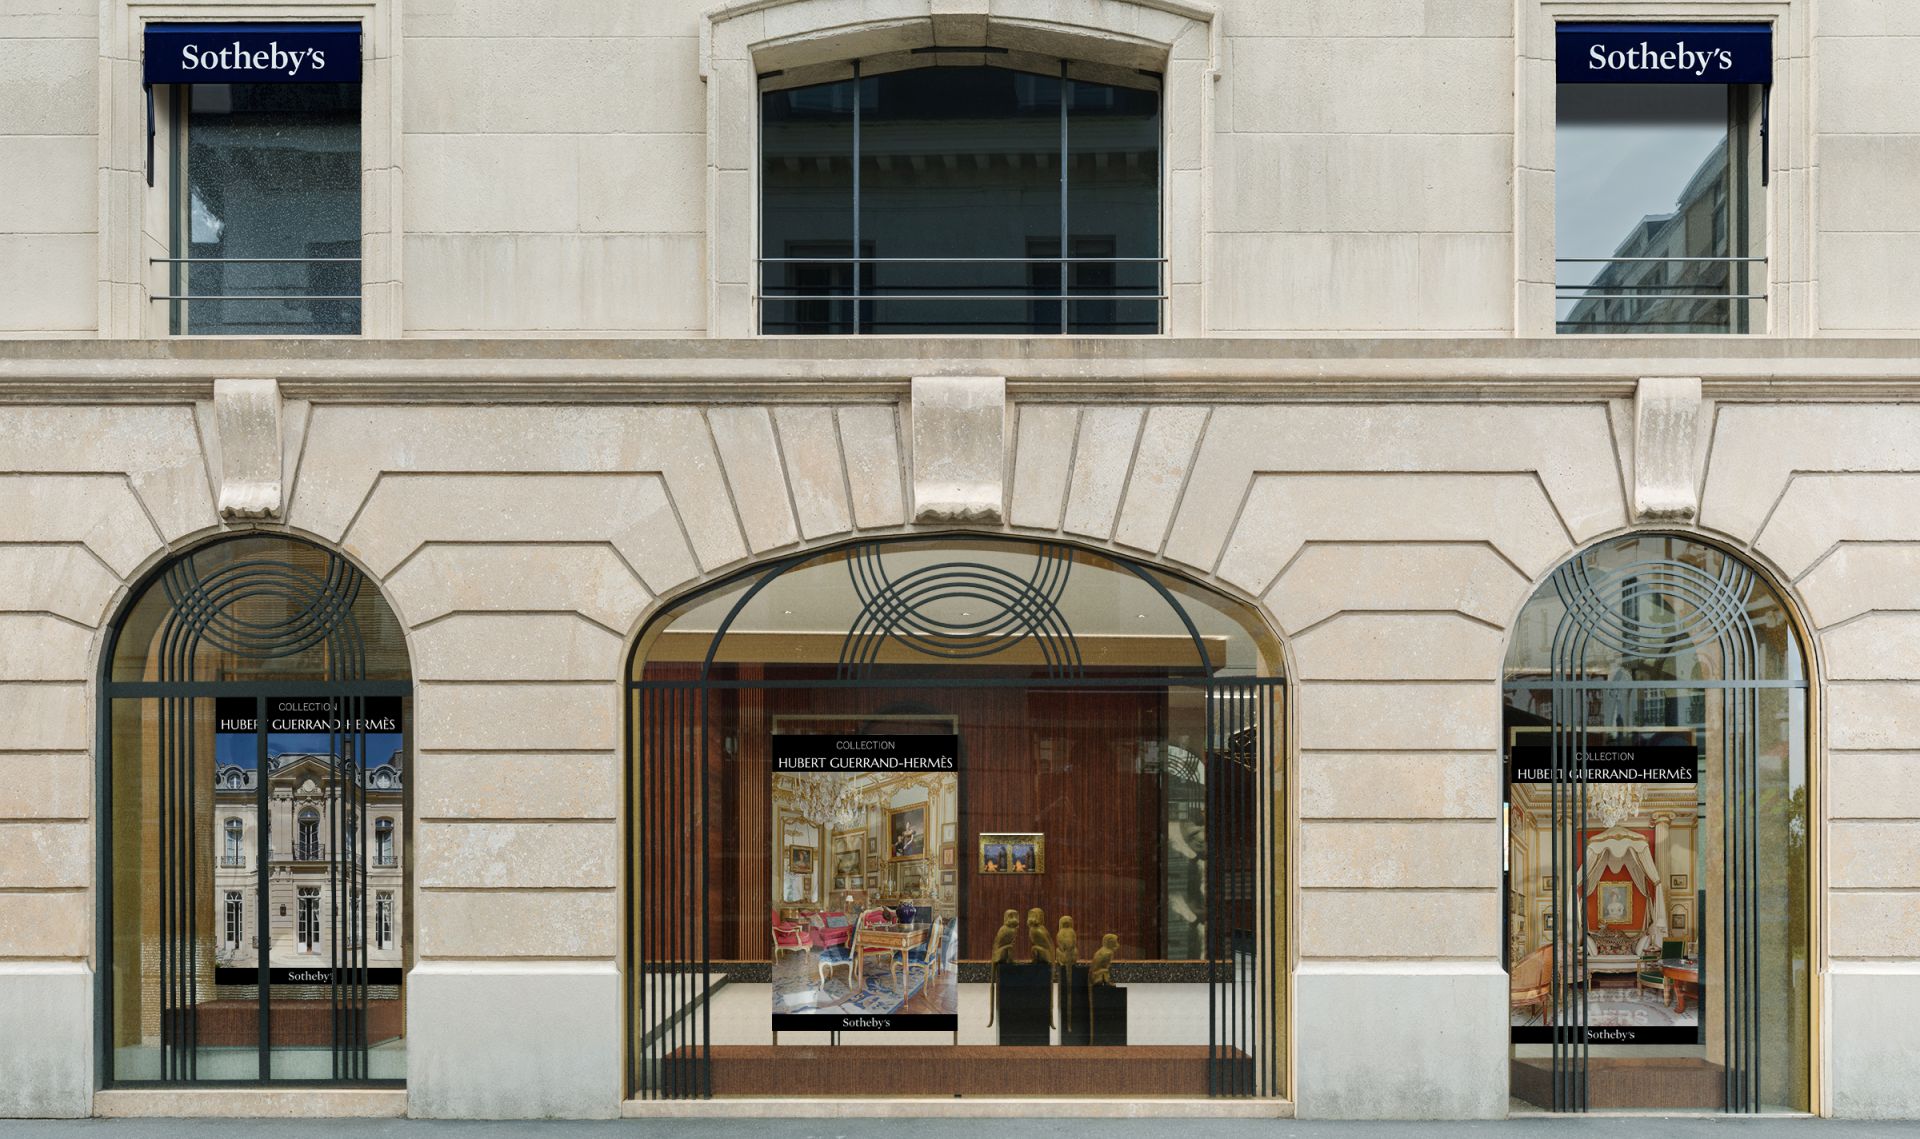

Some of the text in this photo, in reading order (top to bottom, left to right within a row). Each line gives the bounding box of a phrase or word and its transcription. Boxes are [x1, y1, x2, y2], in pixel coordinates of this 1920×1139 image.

[182, 41, 325, 76] Sotheby's
[1589, 41, 1732, 76] Sotheby's
[836, 740, 895, 750] COLLECTION
[778, 755, 953, 769] HUBERT GUERRAND-HERMÈS
[288, 970, 332, 983] Sotheby'
[842, 1017, 891, 1030] Sotheby's
[1587, 1029, 1636, 1042] Sotheby's
